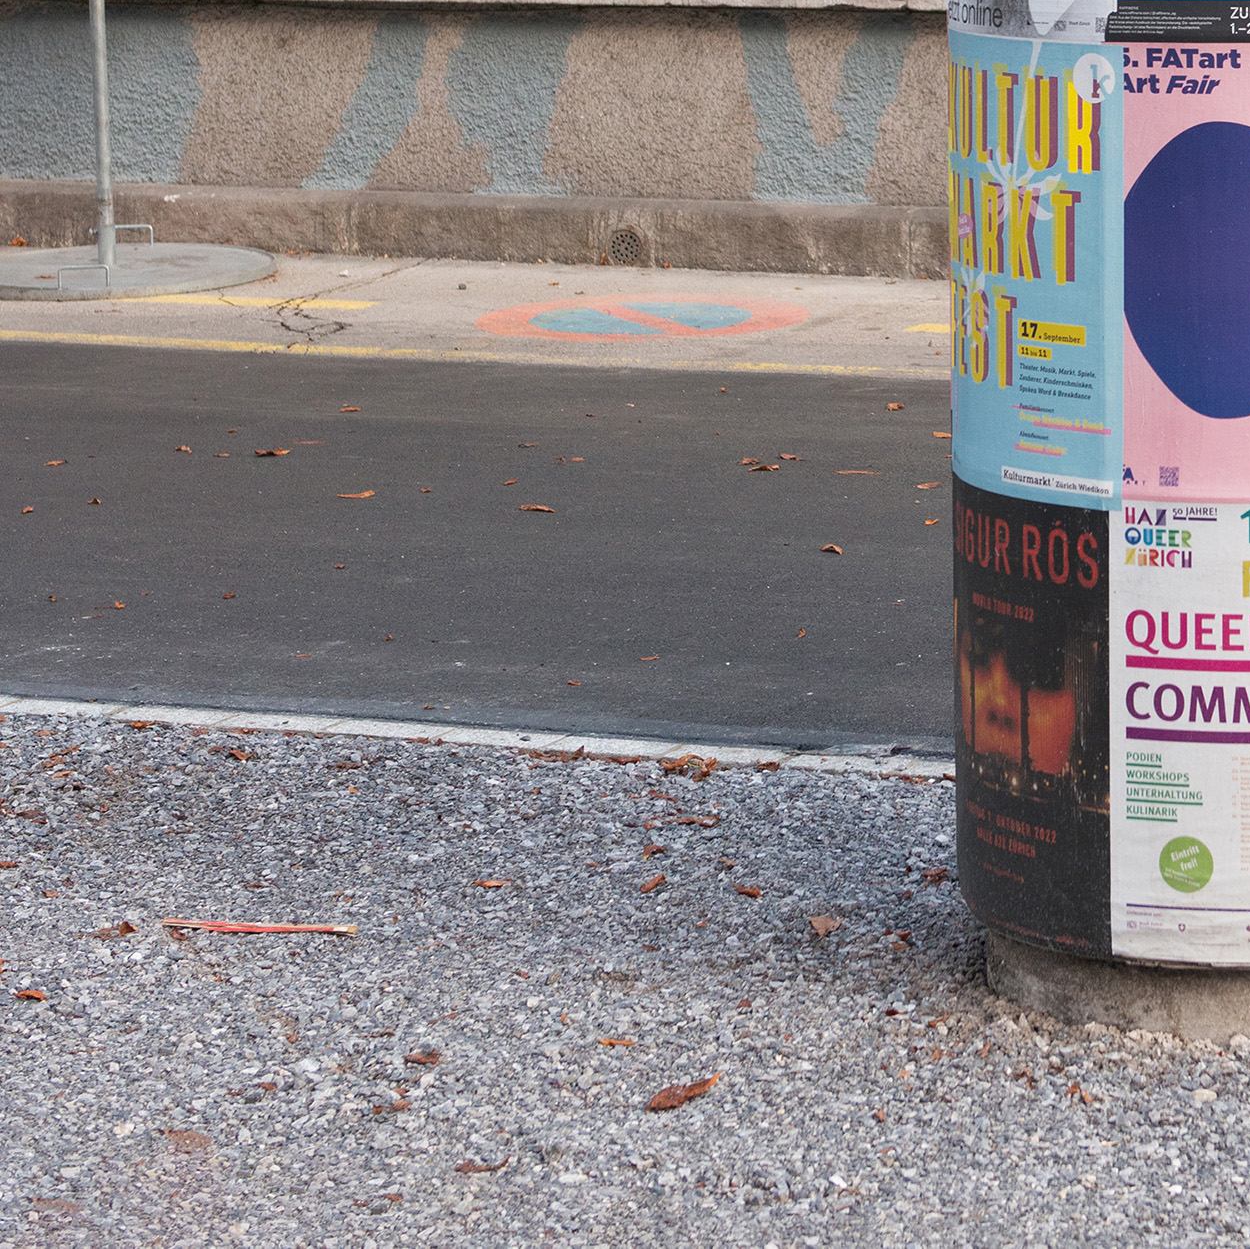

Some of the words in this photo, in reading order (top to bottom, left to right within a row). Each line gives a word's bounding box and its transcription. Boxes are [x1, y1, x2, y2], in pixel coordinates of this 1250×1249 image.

[962, 0, 1003, 27] online
[1146, 48, 1241, 69] FATart
[1123, 73, 1160, 94] Art
[1165, 75, 1221, 95] Fair
[949, 53, 1100, 174] KULTUR
[1021, 322, 1042, 339] 17.
[1043, 333, 1081, 344] September
[1021, 347, 1029, 356] 11
[1038, 349, 1047, 358] 11
[1019, 385, 1037, 395] Spoken
[1038, 388, 1052, 396] Word
[1058, 390, 1091, 400] Breakdance
[1003, 469, 1051, 487] Kulturmarkt
[1055, 480, 1078, 490] Zürich
[1078, 484, 1110, 496] Wiedikon
[1125, 507, 1167, 526] HAZ
[1185, 507, 1218, 518] JAHRE!
[1125, 527, 1192, 548] QUEER
[1022, 520, 1099, 589] RÓS
[1126, 752, 1162, 763] PODIEN
[1126, 769, 1190, 782] WORKSHOPS
[1126, 787, 1203, 801] UNTERHALTUNG
[1126, 805, 1178, 817] KULINARIK
[996, 814, 1031, 837] OKTOBER
[1034, 827, 1057, 844] 2022
[1008, 837, 1036, 859] ZÜRICH
[1170, 845, 1200, 862] Eintritt
